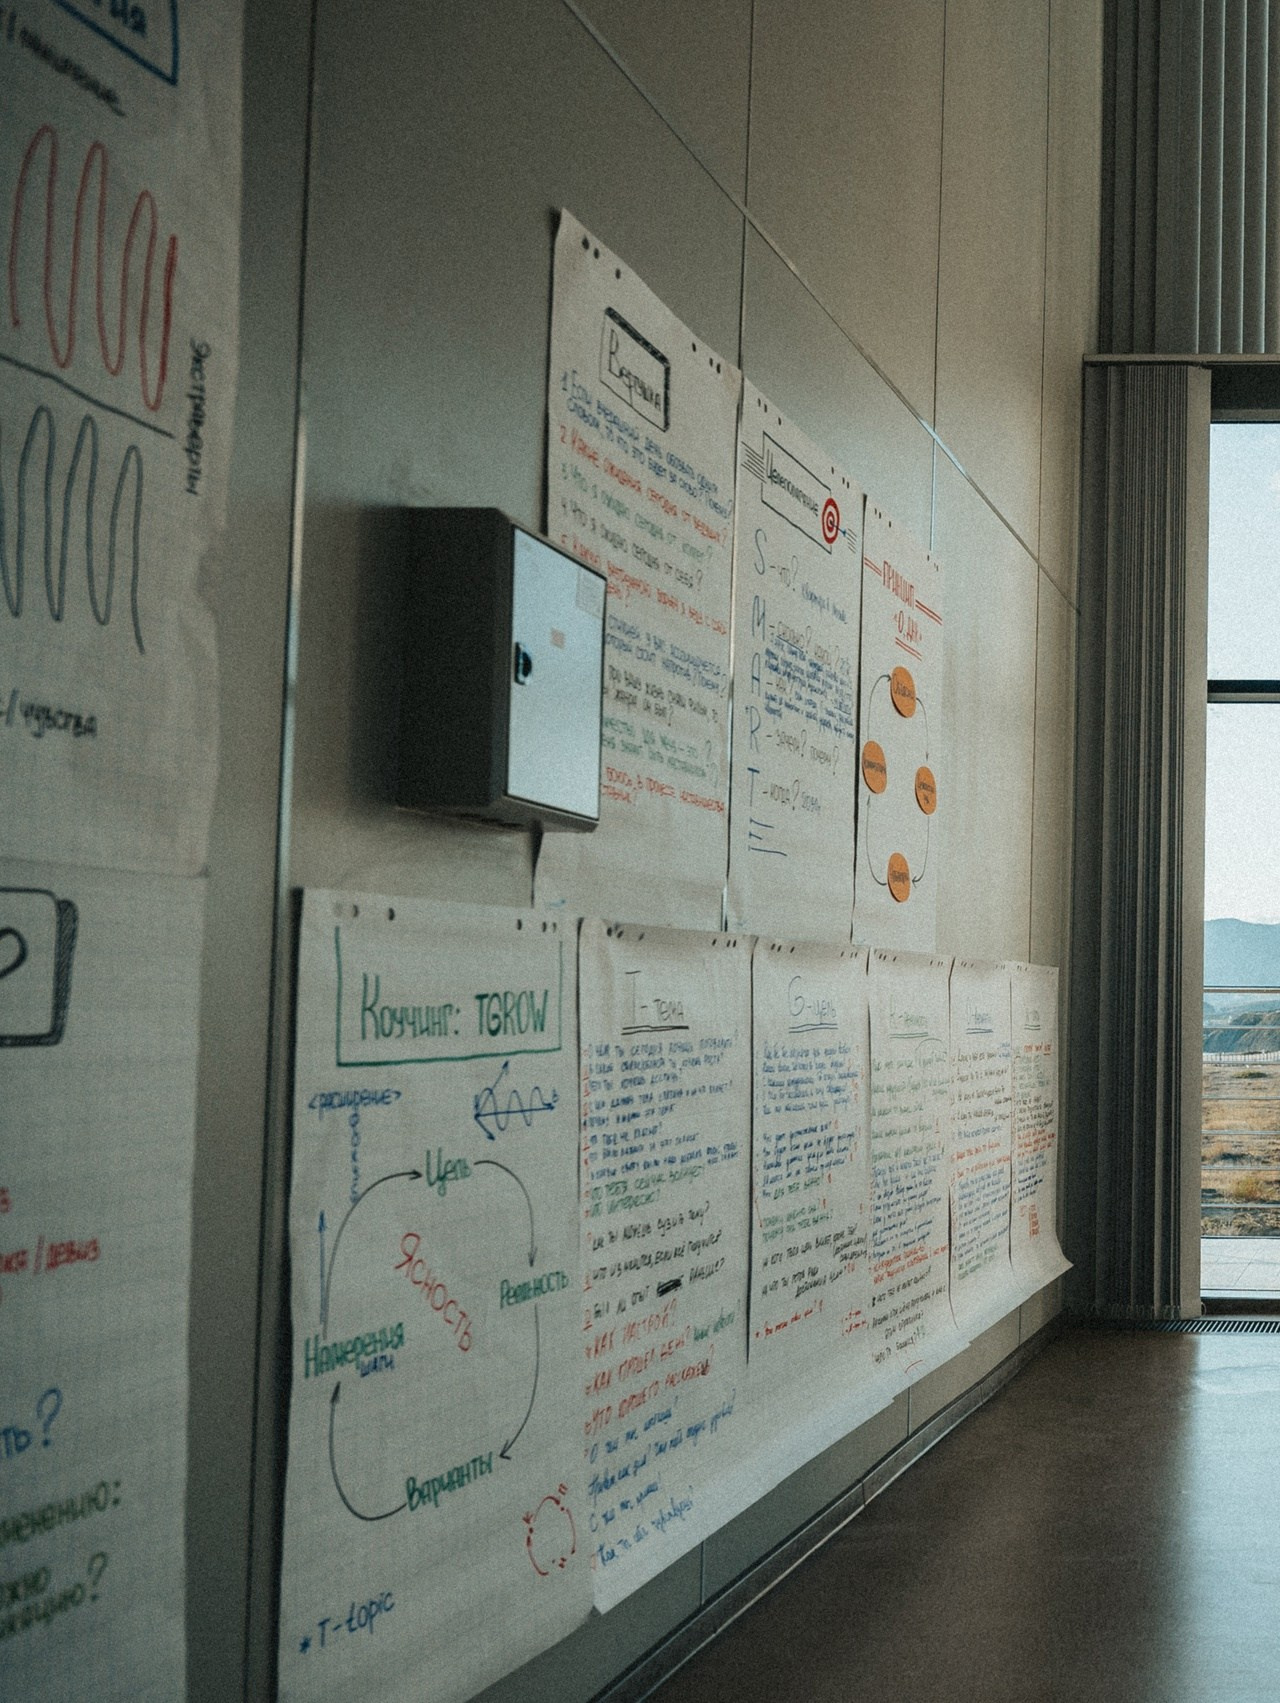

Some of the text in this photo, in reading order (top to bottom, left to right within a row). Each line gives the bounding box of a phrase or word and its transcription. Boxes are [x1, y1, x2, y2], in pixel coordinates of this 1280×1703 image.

[360, 971, 549, 1041] Коучинг: TGROW
[303, 1321, 405, 1380] Намерения
[405, 1451, 493, 1512] Варианты
[316, 1590, 396, 1649] T-topic
